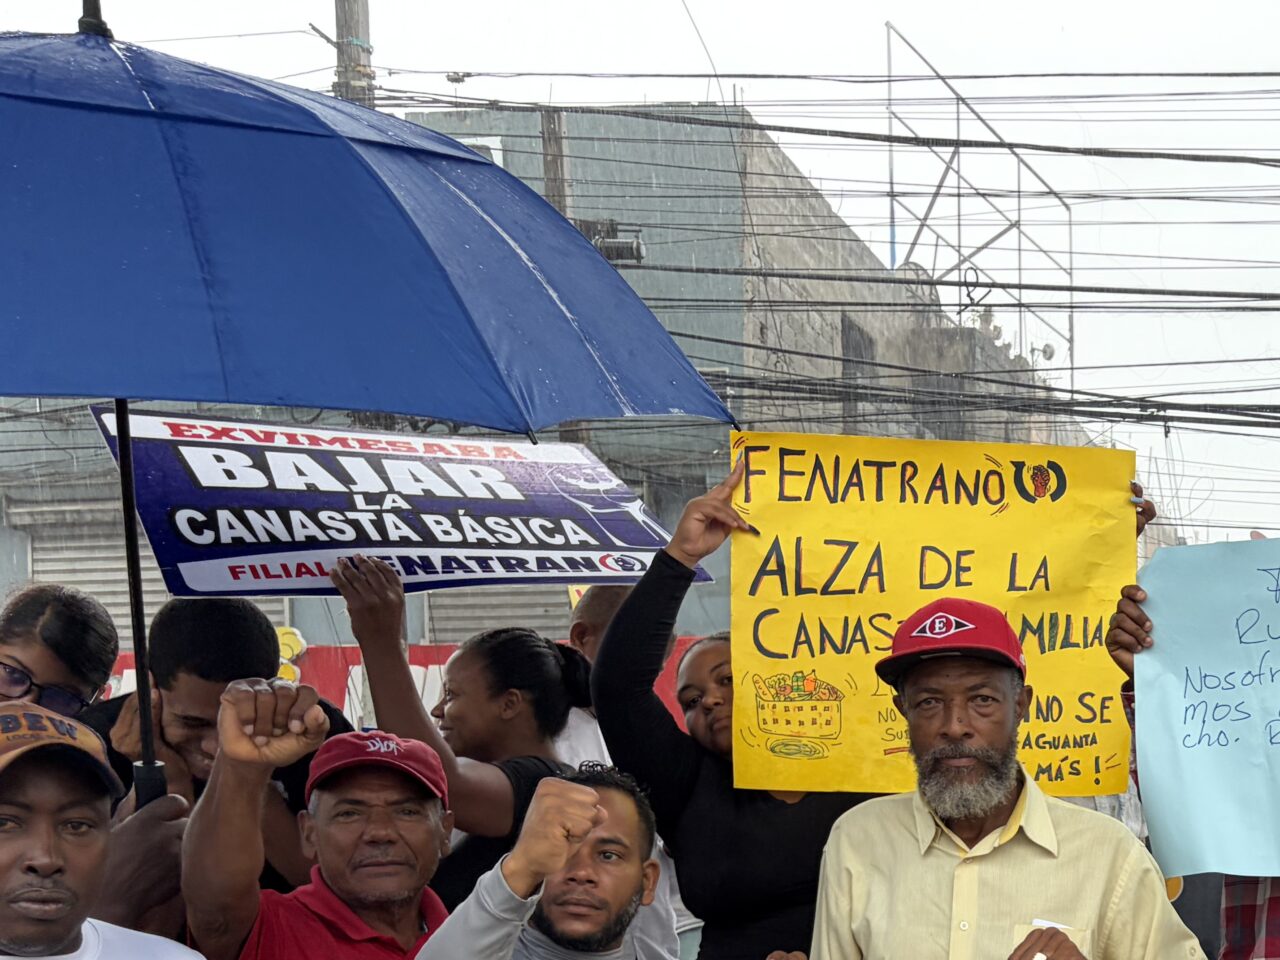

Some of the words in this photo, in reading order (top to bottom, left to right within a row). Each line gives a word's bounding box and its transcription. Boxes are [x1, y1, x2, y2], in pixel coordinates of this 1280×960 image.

[166, 421, 526, 460] EXVIMESABA
[178, 446, 525, 500] BAJAR
[350, 493, 410, 512] LA
[175, 508, 416, 545] CANASTA
[429, 508, 600, 546] BÁSICA
[228, 559, 331, 581] FILIAL
[748, 535, 888, 597] ALZA
[918, 545, 975, 590] DE
[1007, 552, 1050, 592] LA
[753, 608, 900, 660] CANAS
[1018, 611, 1105, 655] MILIA
[933, 617, 947, 633] E
[878, 707, 897, 723] NO
[1036, 695, 1063, 722] NO
[1075, 692, 1114, 723] SE
[1022, 731, 1098, 750] AGUANTA
[1034, 755, 1081, 781] MÁS
